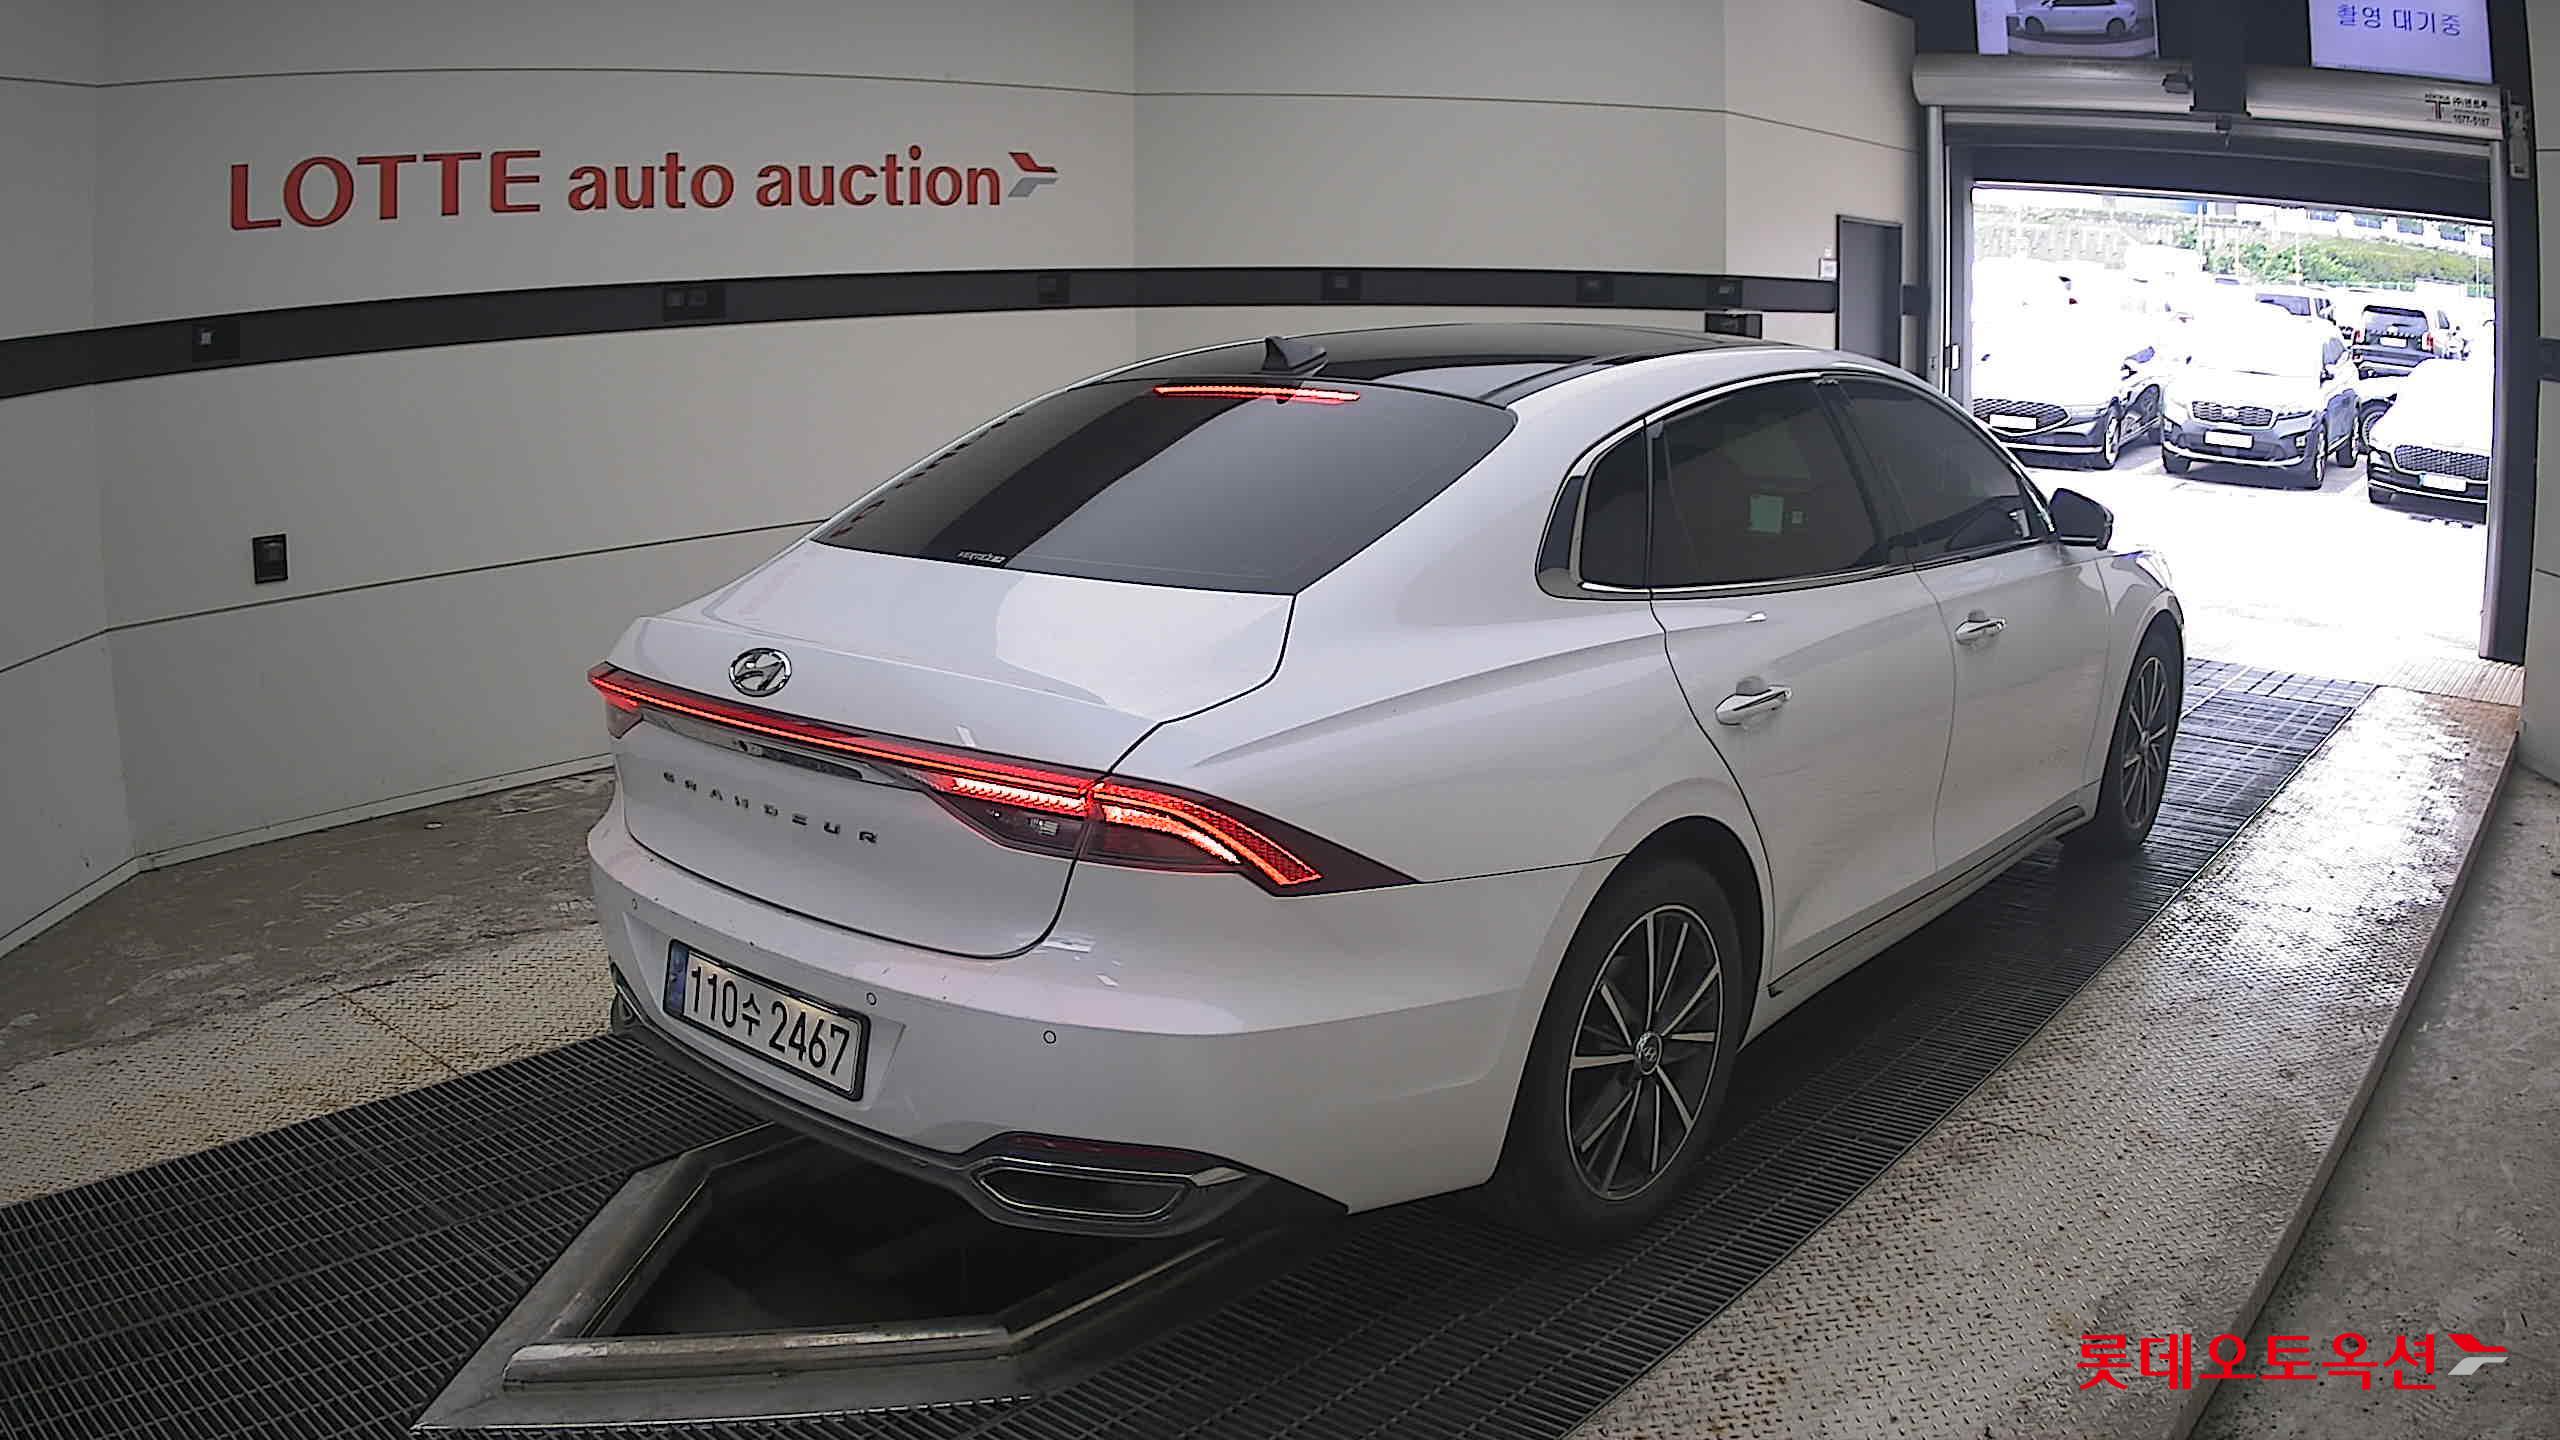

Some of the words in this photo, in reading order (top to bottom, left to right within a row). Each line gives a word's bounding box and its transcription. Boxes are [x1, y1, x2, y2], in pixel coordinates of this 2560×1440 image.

[2337, 3, 2382, 29] 촬영
[2392, 8, 2461, 37] 대기중
[231, 150, 542, 231] LOTTE
[568, 152, 735, 211] auto
[756, 145, 1002, 207] auction
[662, 770, 879, 845] GRANDEUR
[690, 965, 762, 1036] 110수
[768, 1000, 851, 1076] 2467
